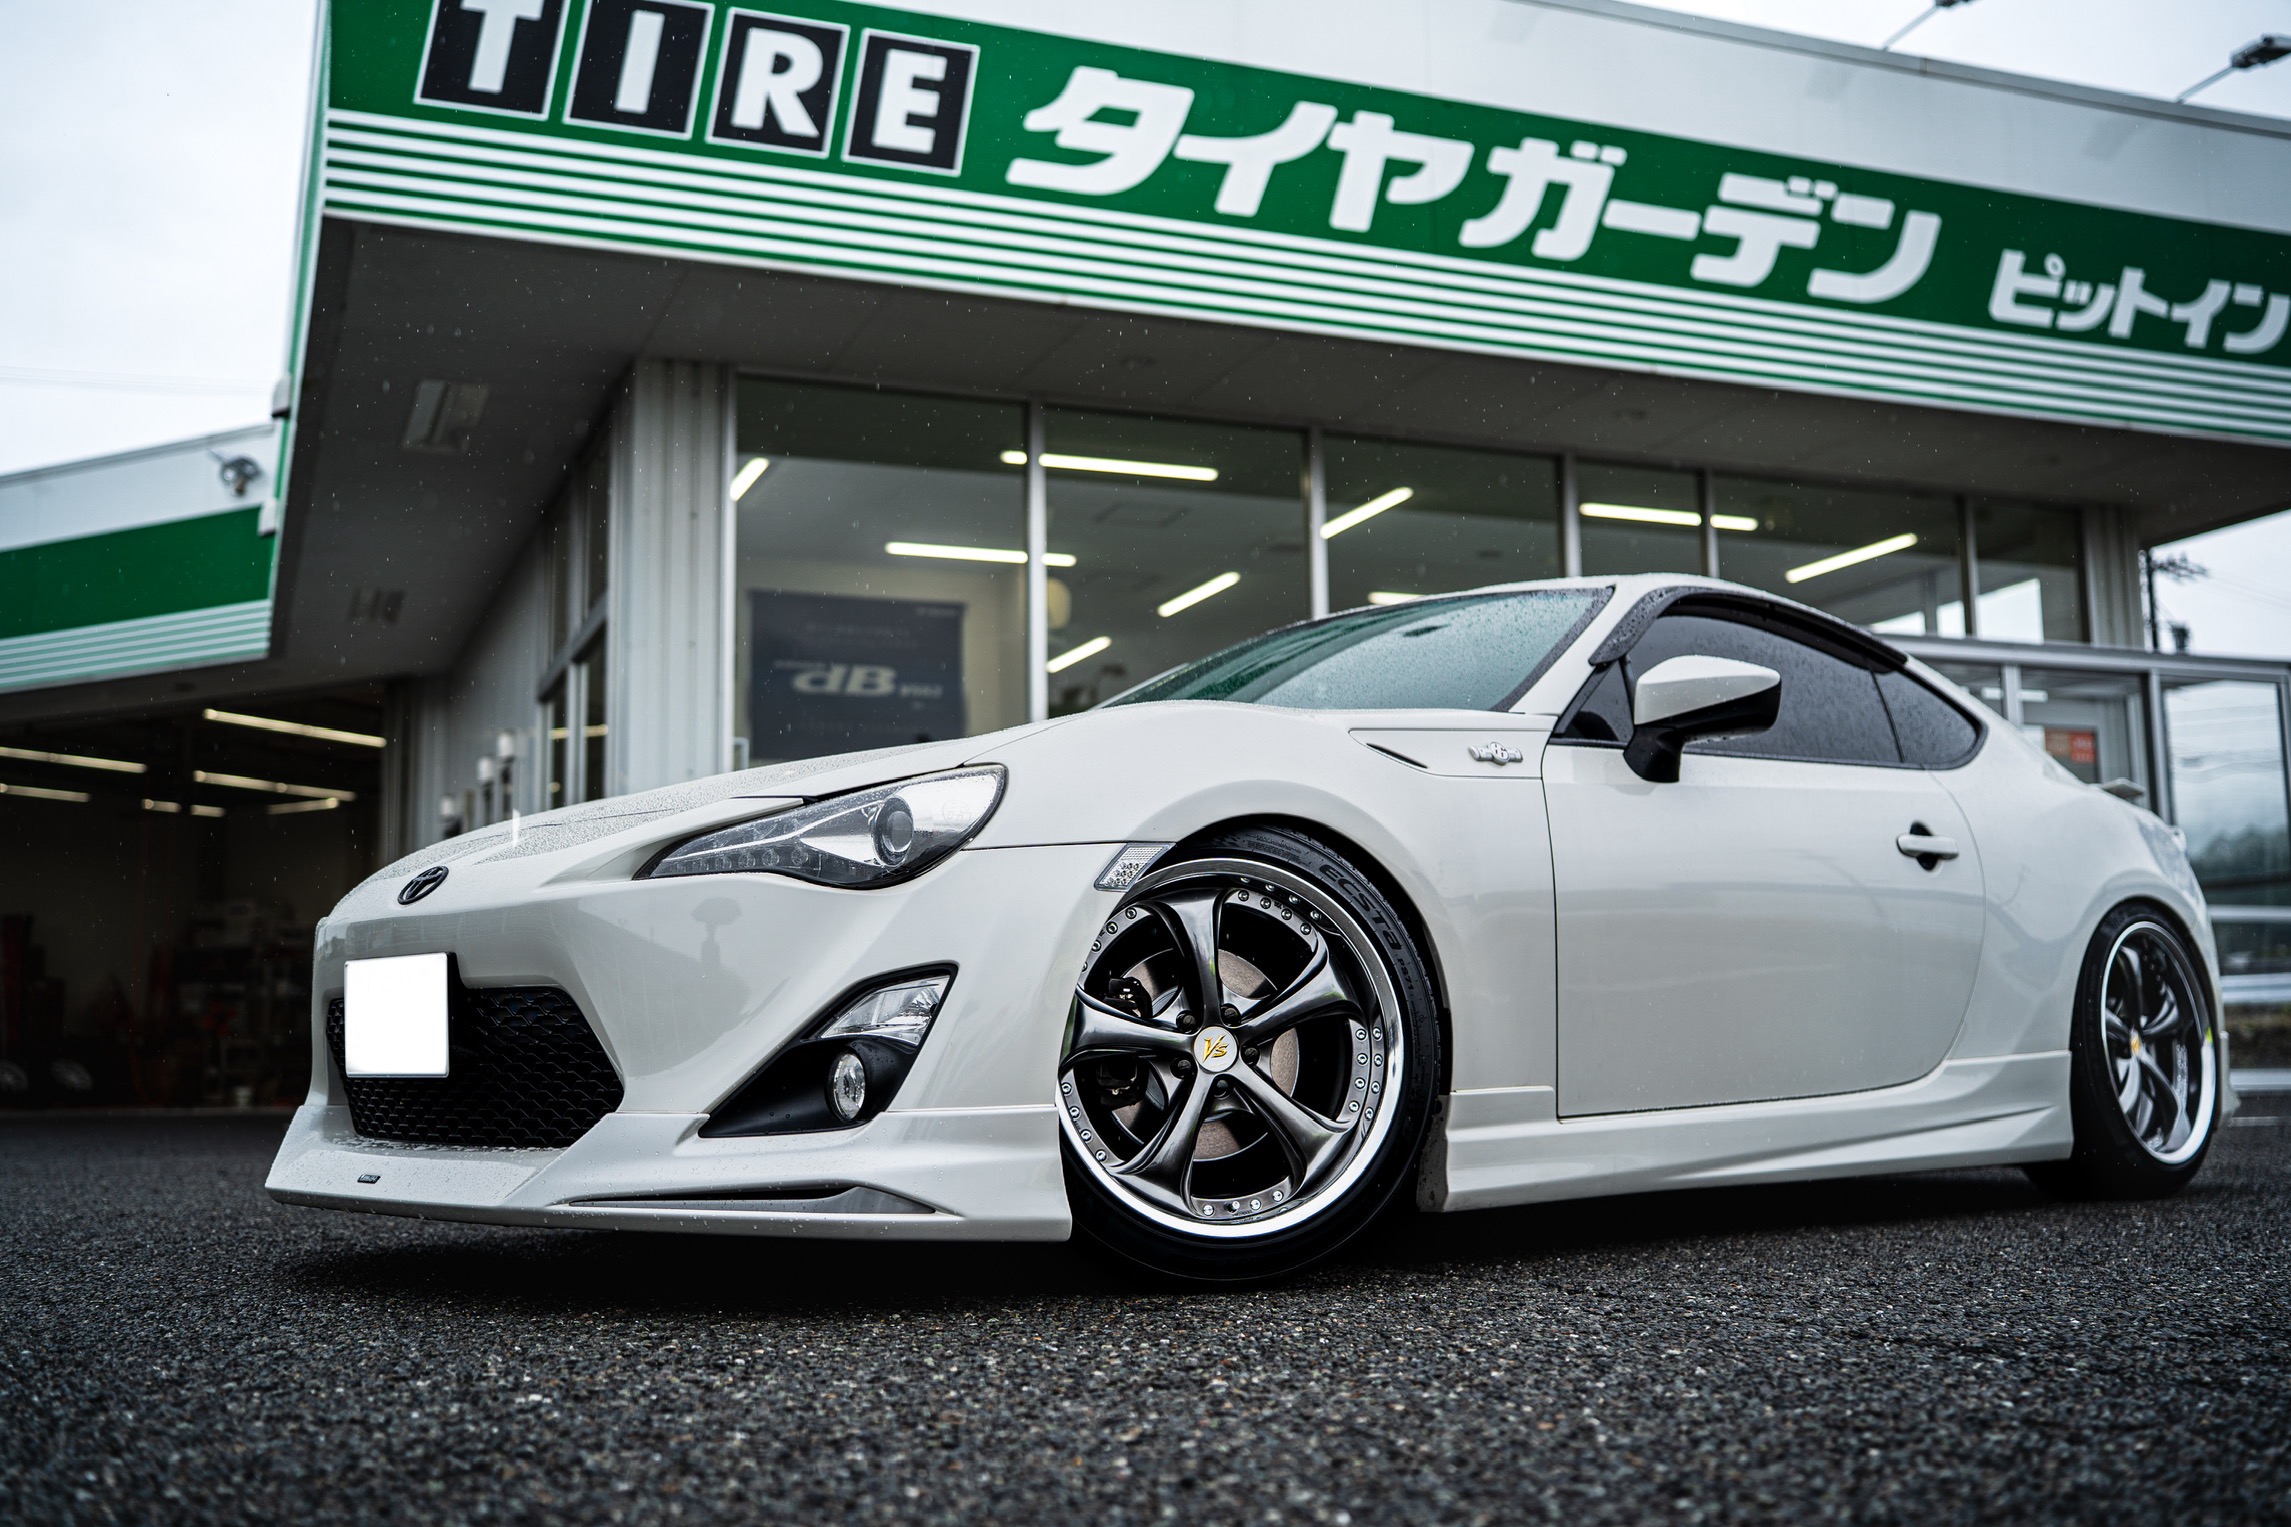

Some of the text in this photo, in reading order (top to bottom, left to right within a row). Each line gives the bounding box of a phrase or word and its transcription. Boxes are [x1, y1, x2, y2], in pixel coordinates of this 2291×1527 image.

[461, 0, 948, 154] TIRE
[1005, 65, 2291, 355] タイヤガーデン ピットイン
[793, 662, 898, 697] dB
